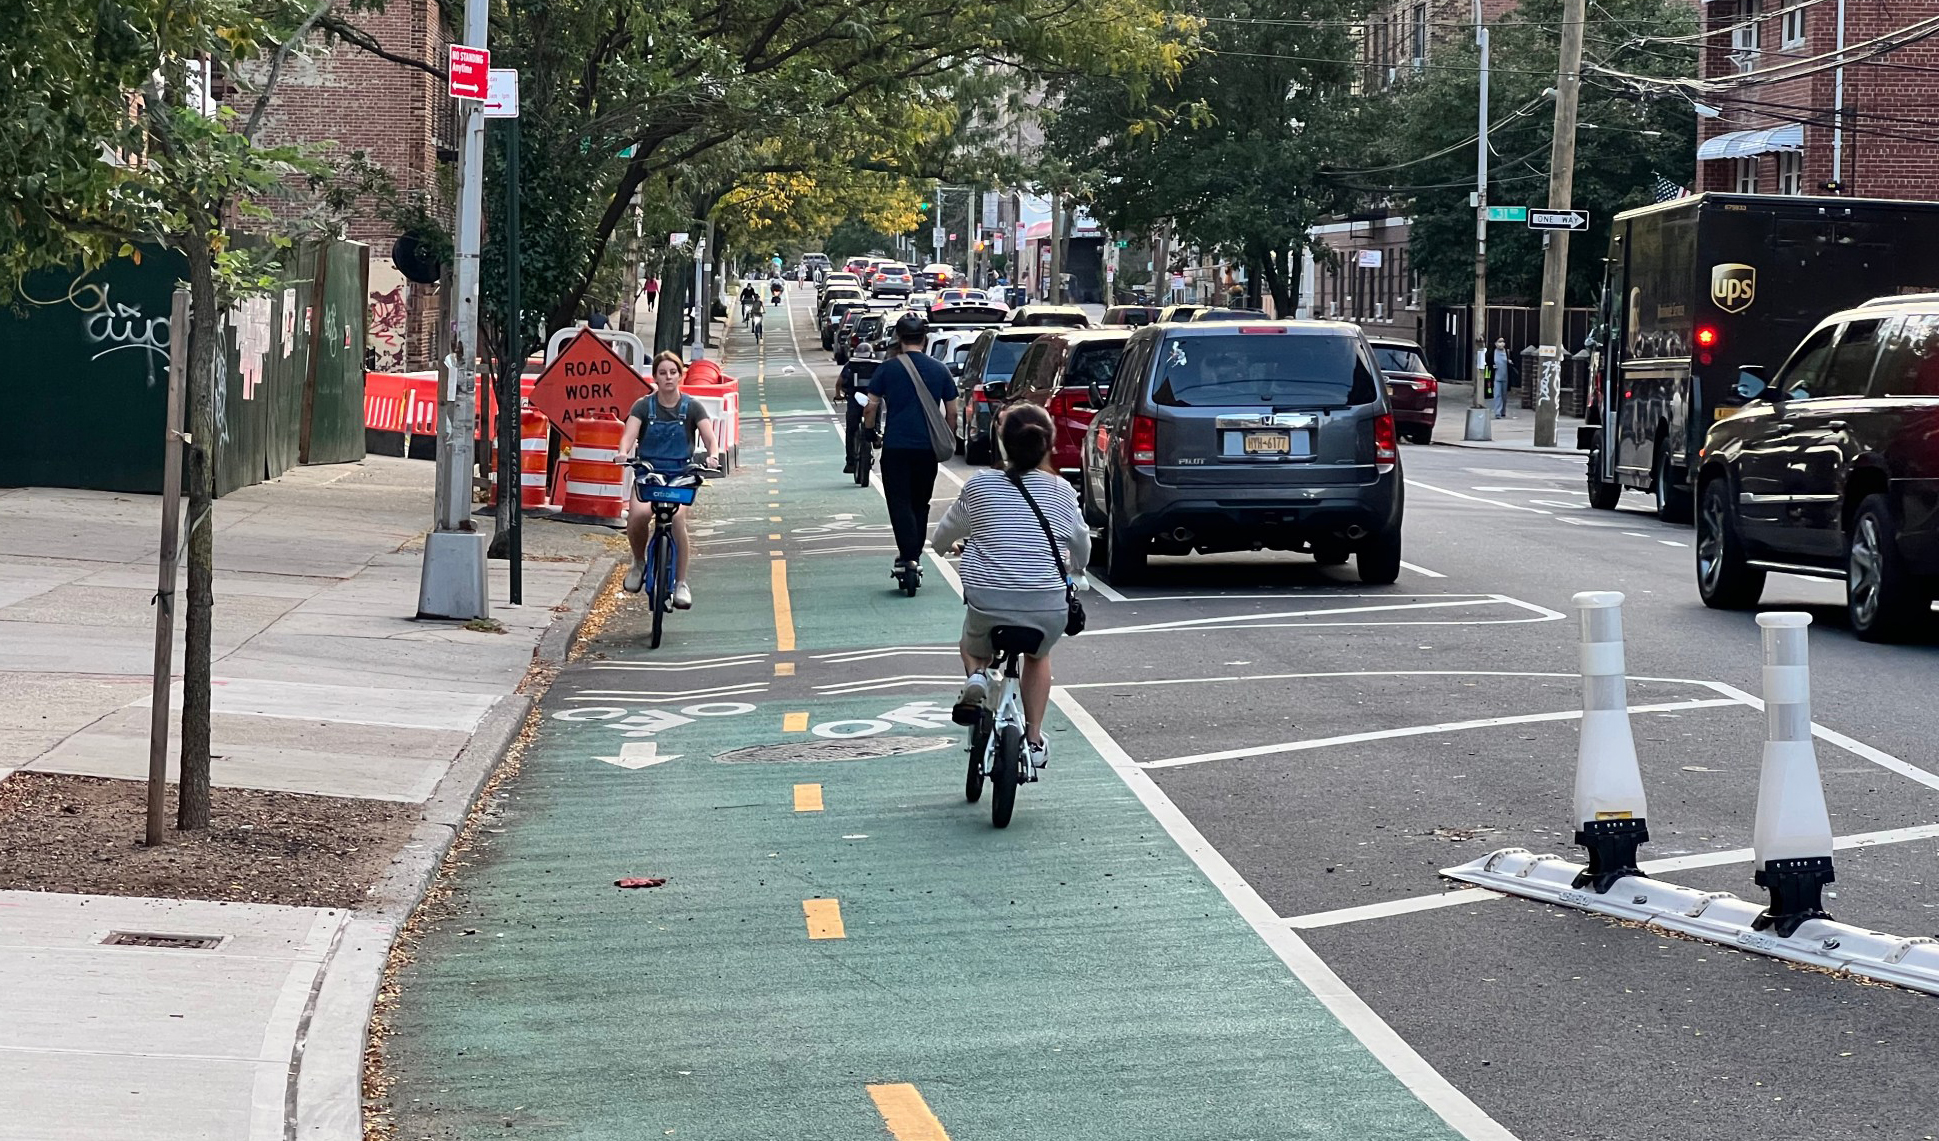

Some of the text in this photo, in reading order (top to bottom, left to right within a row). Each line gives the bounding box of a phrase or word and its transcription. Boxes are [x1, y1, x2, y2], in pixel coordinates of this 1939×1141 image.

[452, 50, 483, 64] NO STANDING
[452, 62, 473, 73] Anytime
[1537, 215, 1579, 224] ONE WAY
[1714, 278, 1752, 306] ups
[564, 360, 611, 377] ROAD
[565, 383, 613, 401] WORK
[1178, 457, 1206, 465] PILOT
